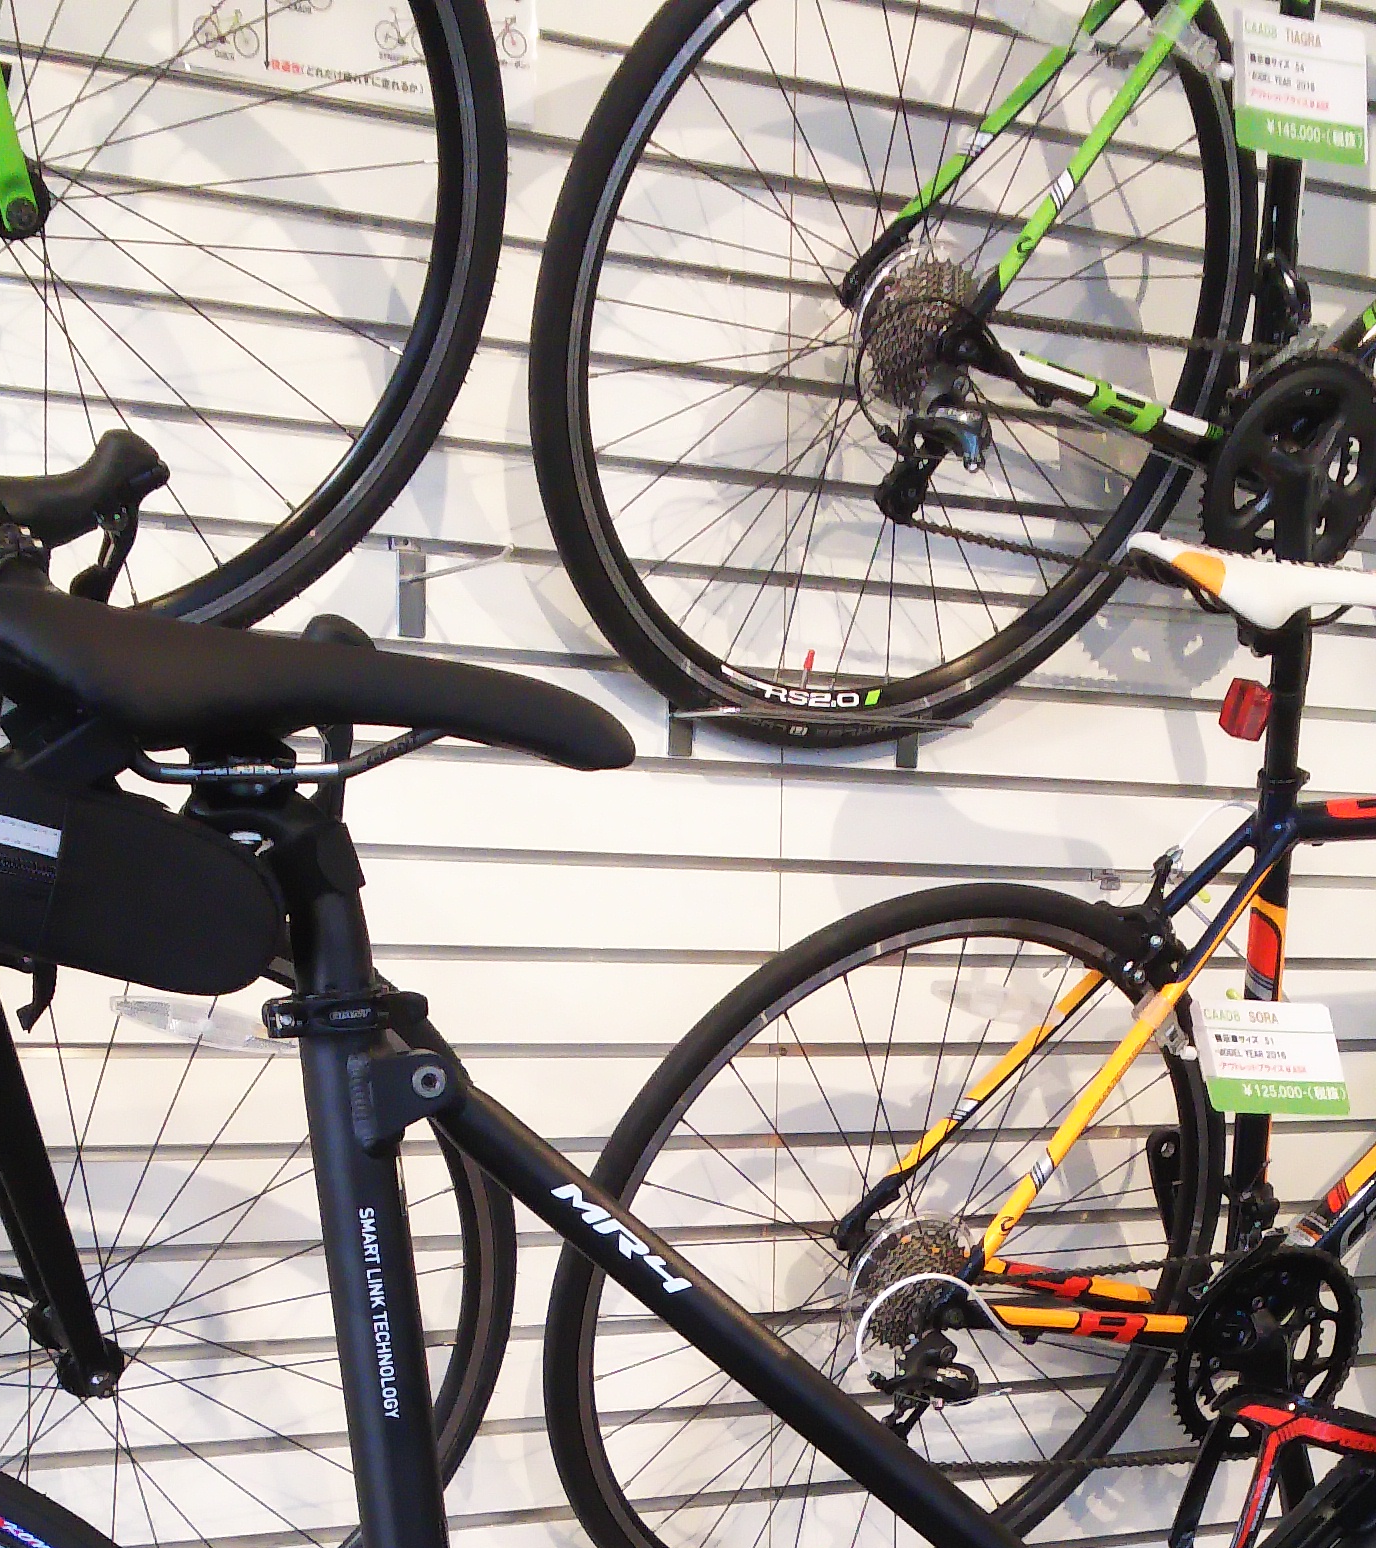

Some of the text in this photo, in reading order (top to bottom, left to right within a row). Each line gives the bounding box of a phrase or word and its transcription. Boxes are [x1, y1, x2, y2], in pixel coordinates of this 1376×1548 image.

[1286, 28, 1322, 48] TIAGRA
[1248, 1011, 1279, 1024] SORA
[1245, 1050, 1264, 1059] YEAR
[550, 1183, 694, 1295] MR4
[358, 1206, 400, 1419] SMART LINK TECHNOLOGY
